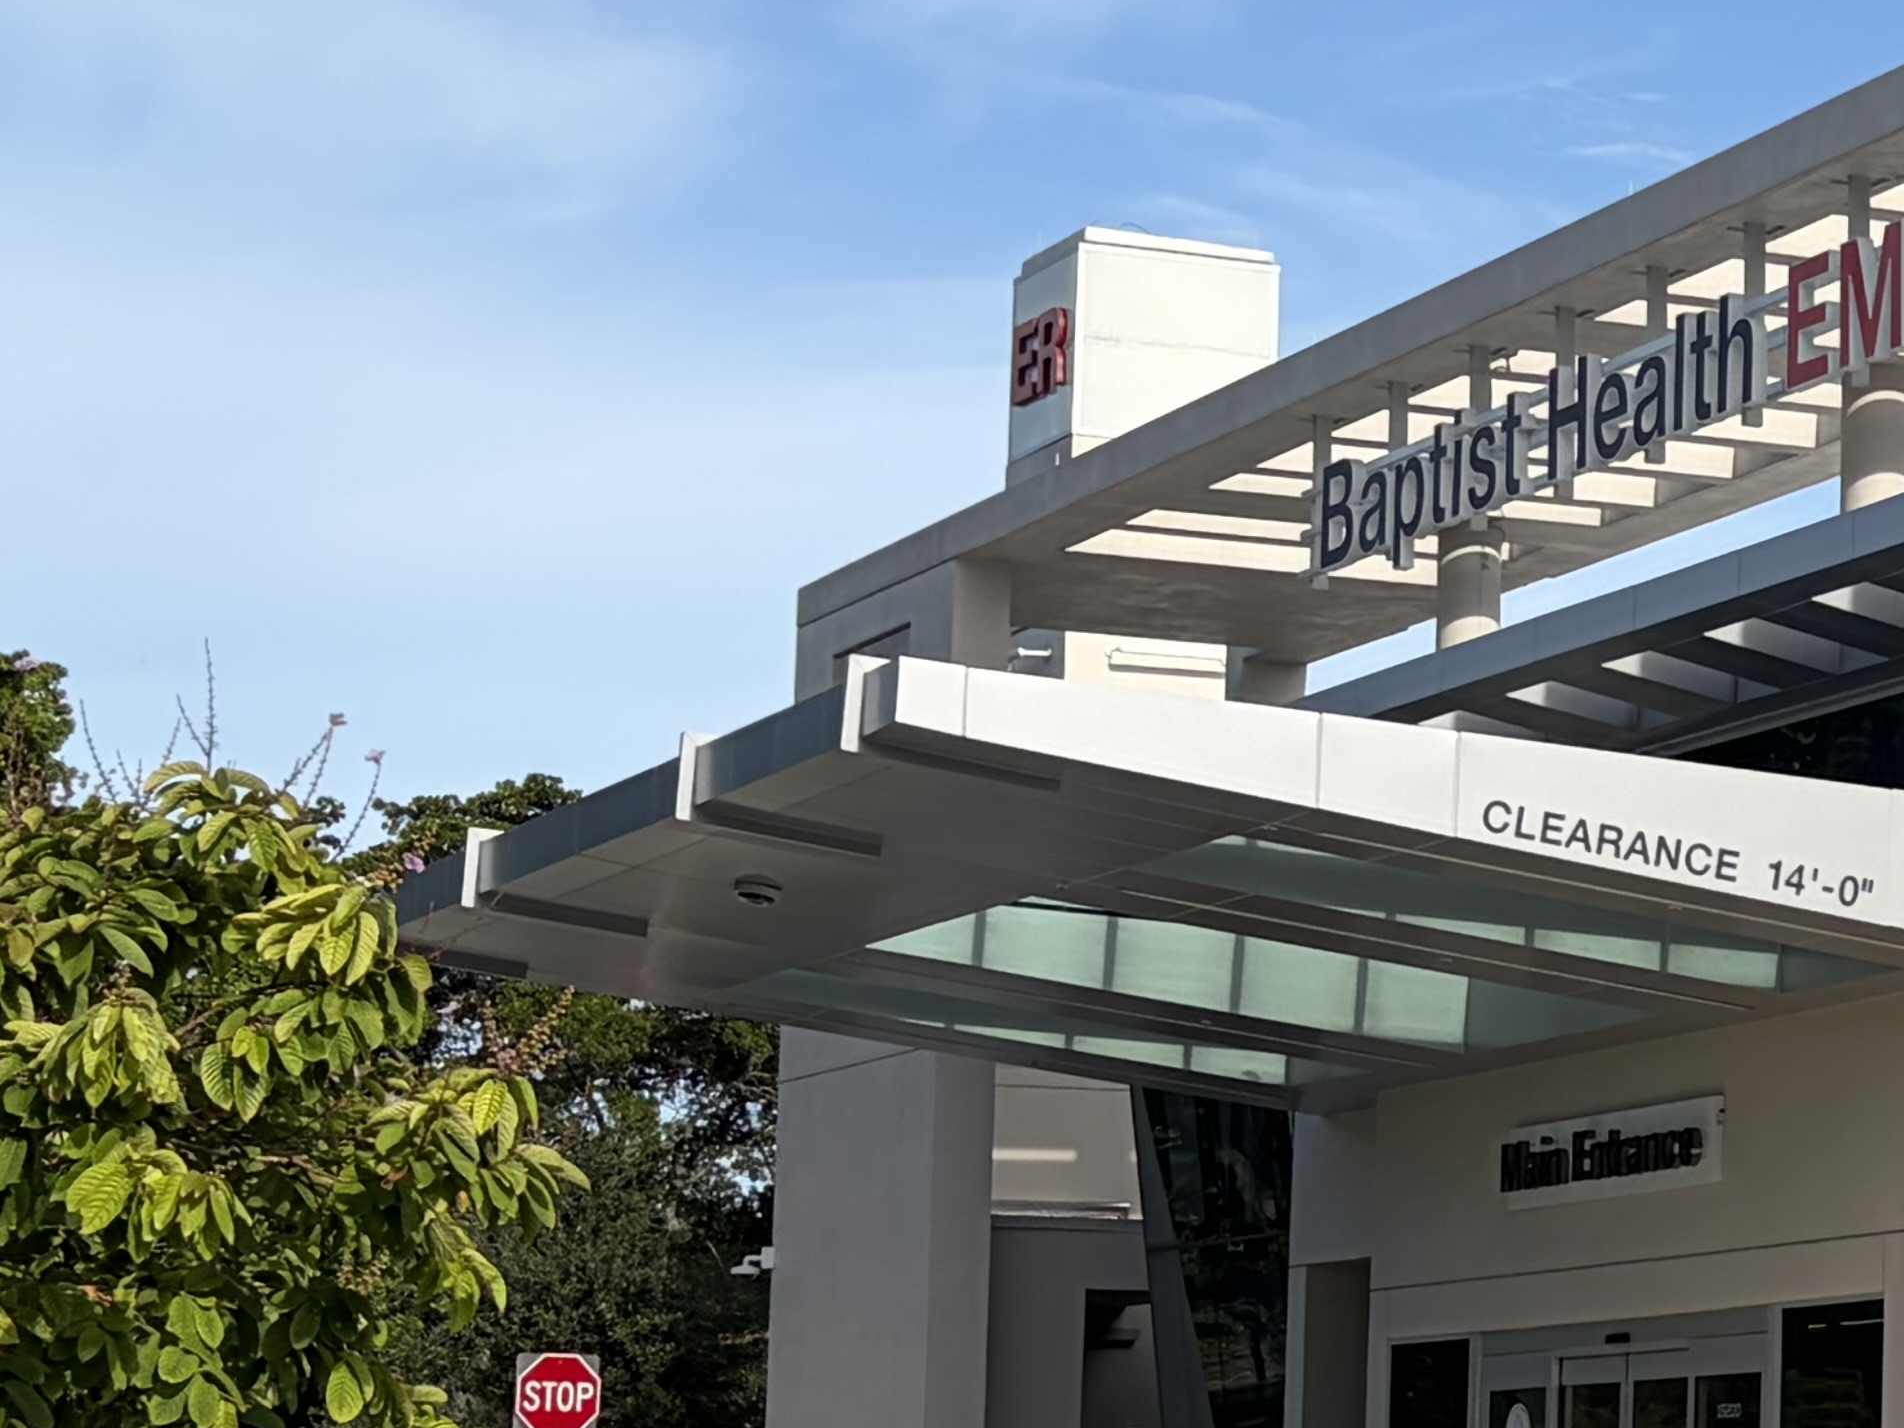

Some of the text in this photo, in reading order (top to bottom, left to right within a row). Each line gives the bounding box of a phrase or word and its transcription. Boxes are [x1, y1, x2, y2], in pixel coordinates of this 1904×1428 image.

[1011, 306, 1070, 408] ER
[1320, 392, 1522, 570] Baptist
[1547, 293, 1756, 480] Health
[1481, 799, 1875, 908] CLEARANCE 14'-0"
[1500, 1126, 1704, 1193] Main Entrance
[522, 1379, 595, 1413] STOP
